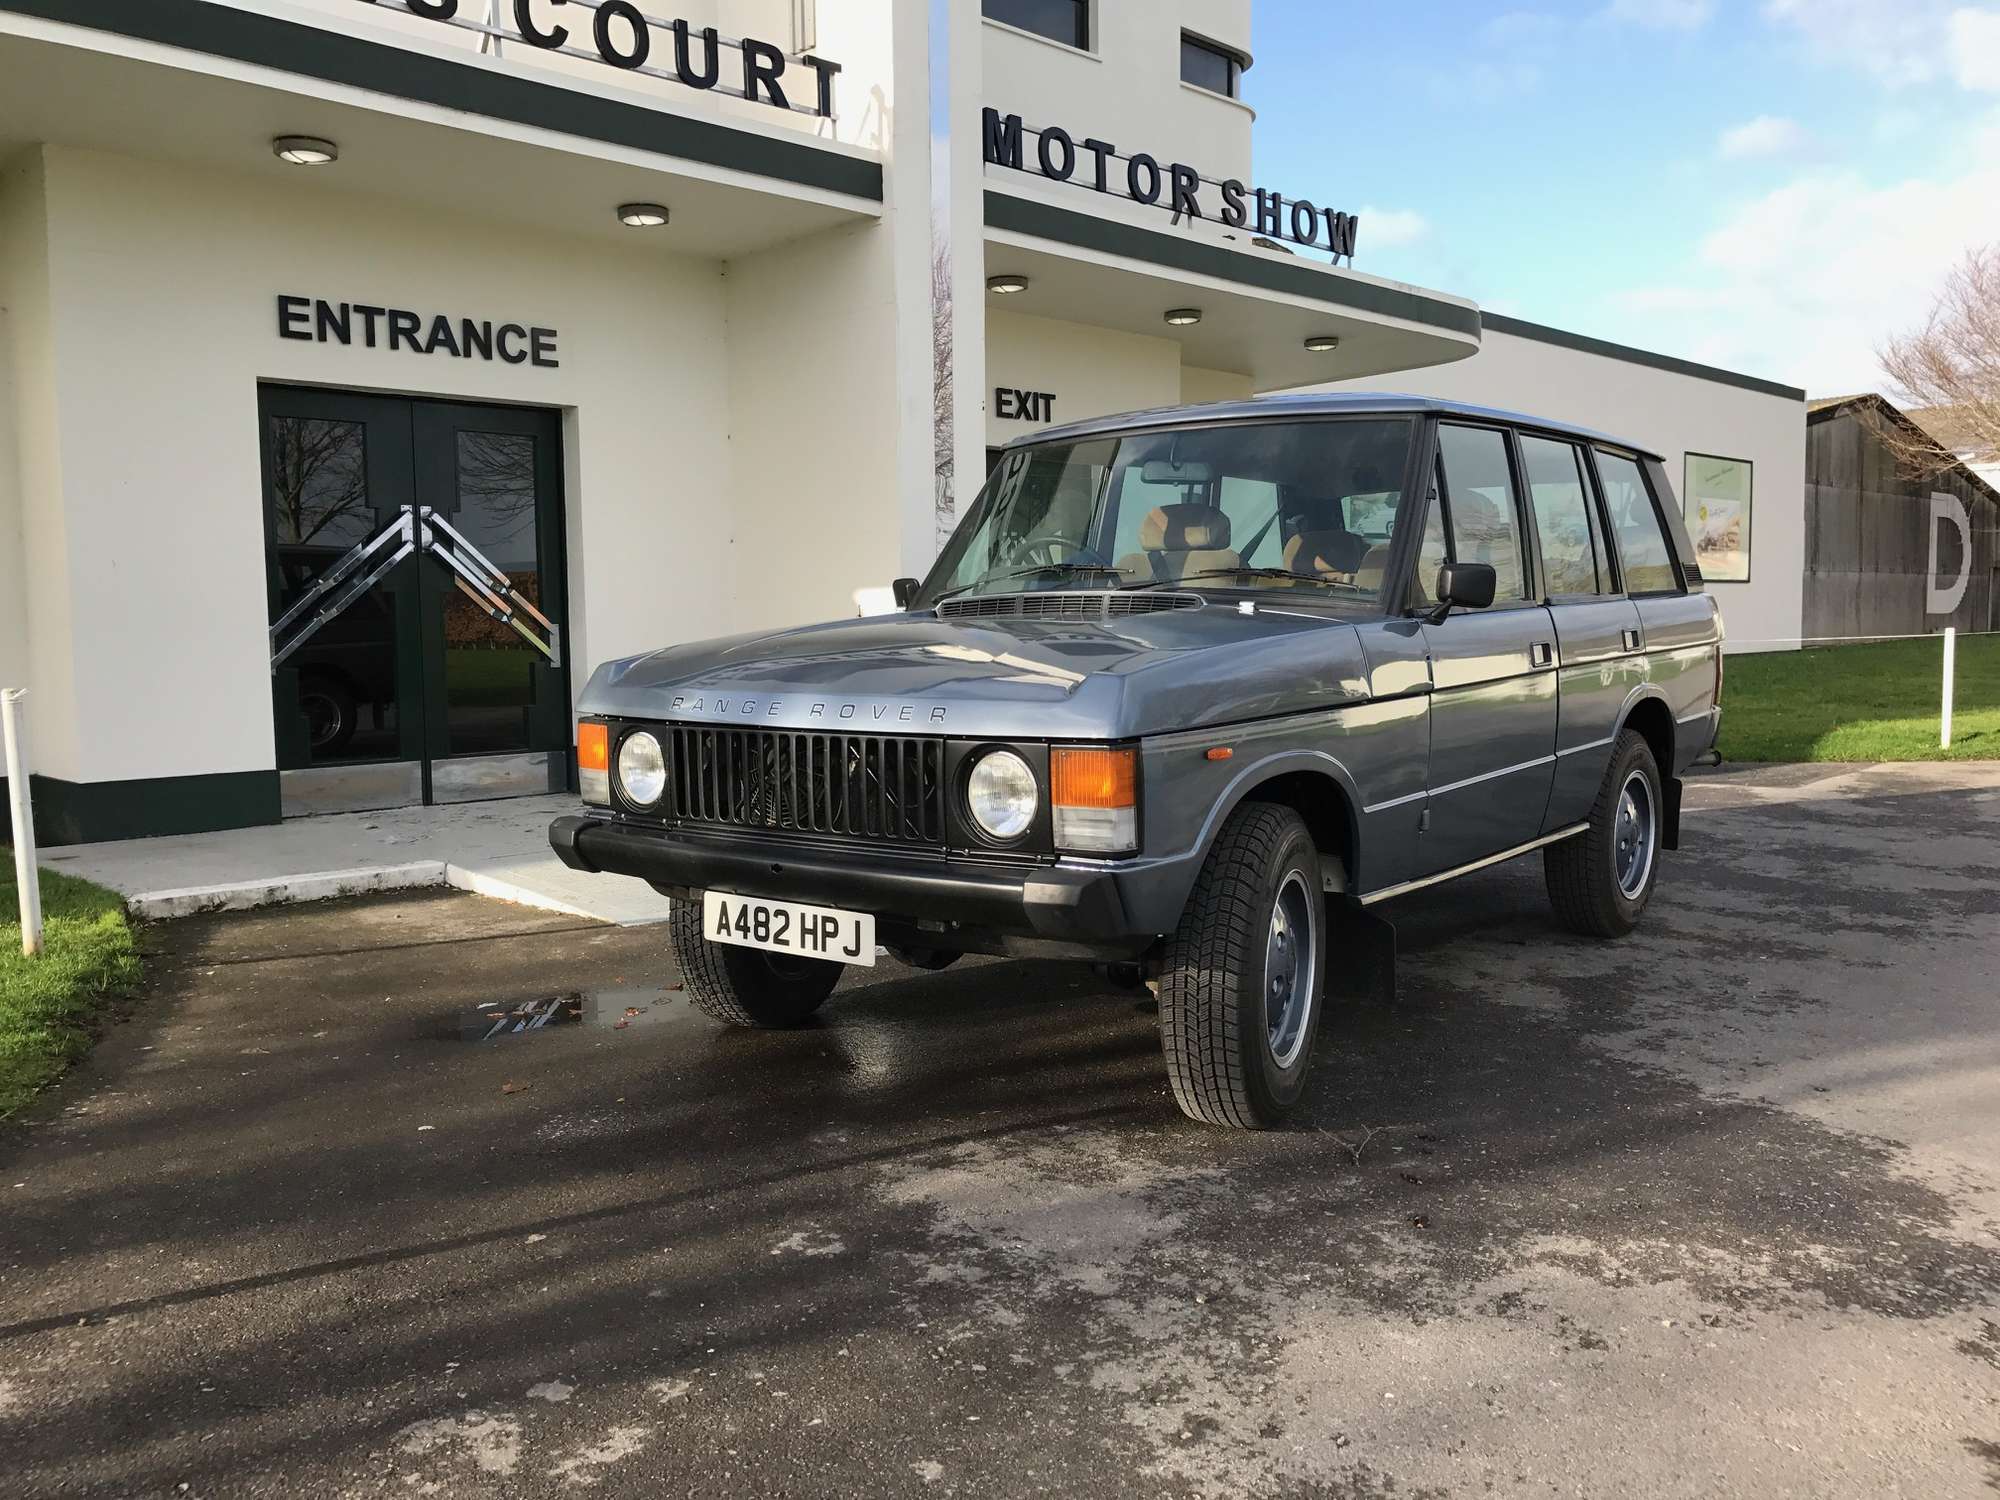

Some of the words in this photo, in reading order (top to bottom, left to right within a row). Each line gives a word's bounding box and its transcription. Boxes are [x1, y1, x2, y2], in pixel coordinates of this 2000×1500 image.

[513, 0, 841, 117] COURT
[982, 107, 1201, 217] MOTOR
[1221, 179, 1359, 257] SHOW
[278, 294, 560, 368] ENTRANCE
[995, 387, 1056, 422] EXIT
[1926, 492, 1972, 613] D
[670, 696, 782, 716] RANGE
[809, 703, 947, 723] ROVER
[716, 900, 791, 947] A482
[800, 912, 861, 957] HPJ
